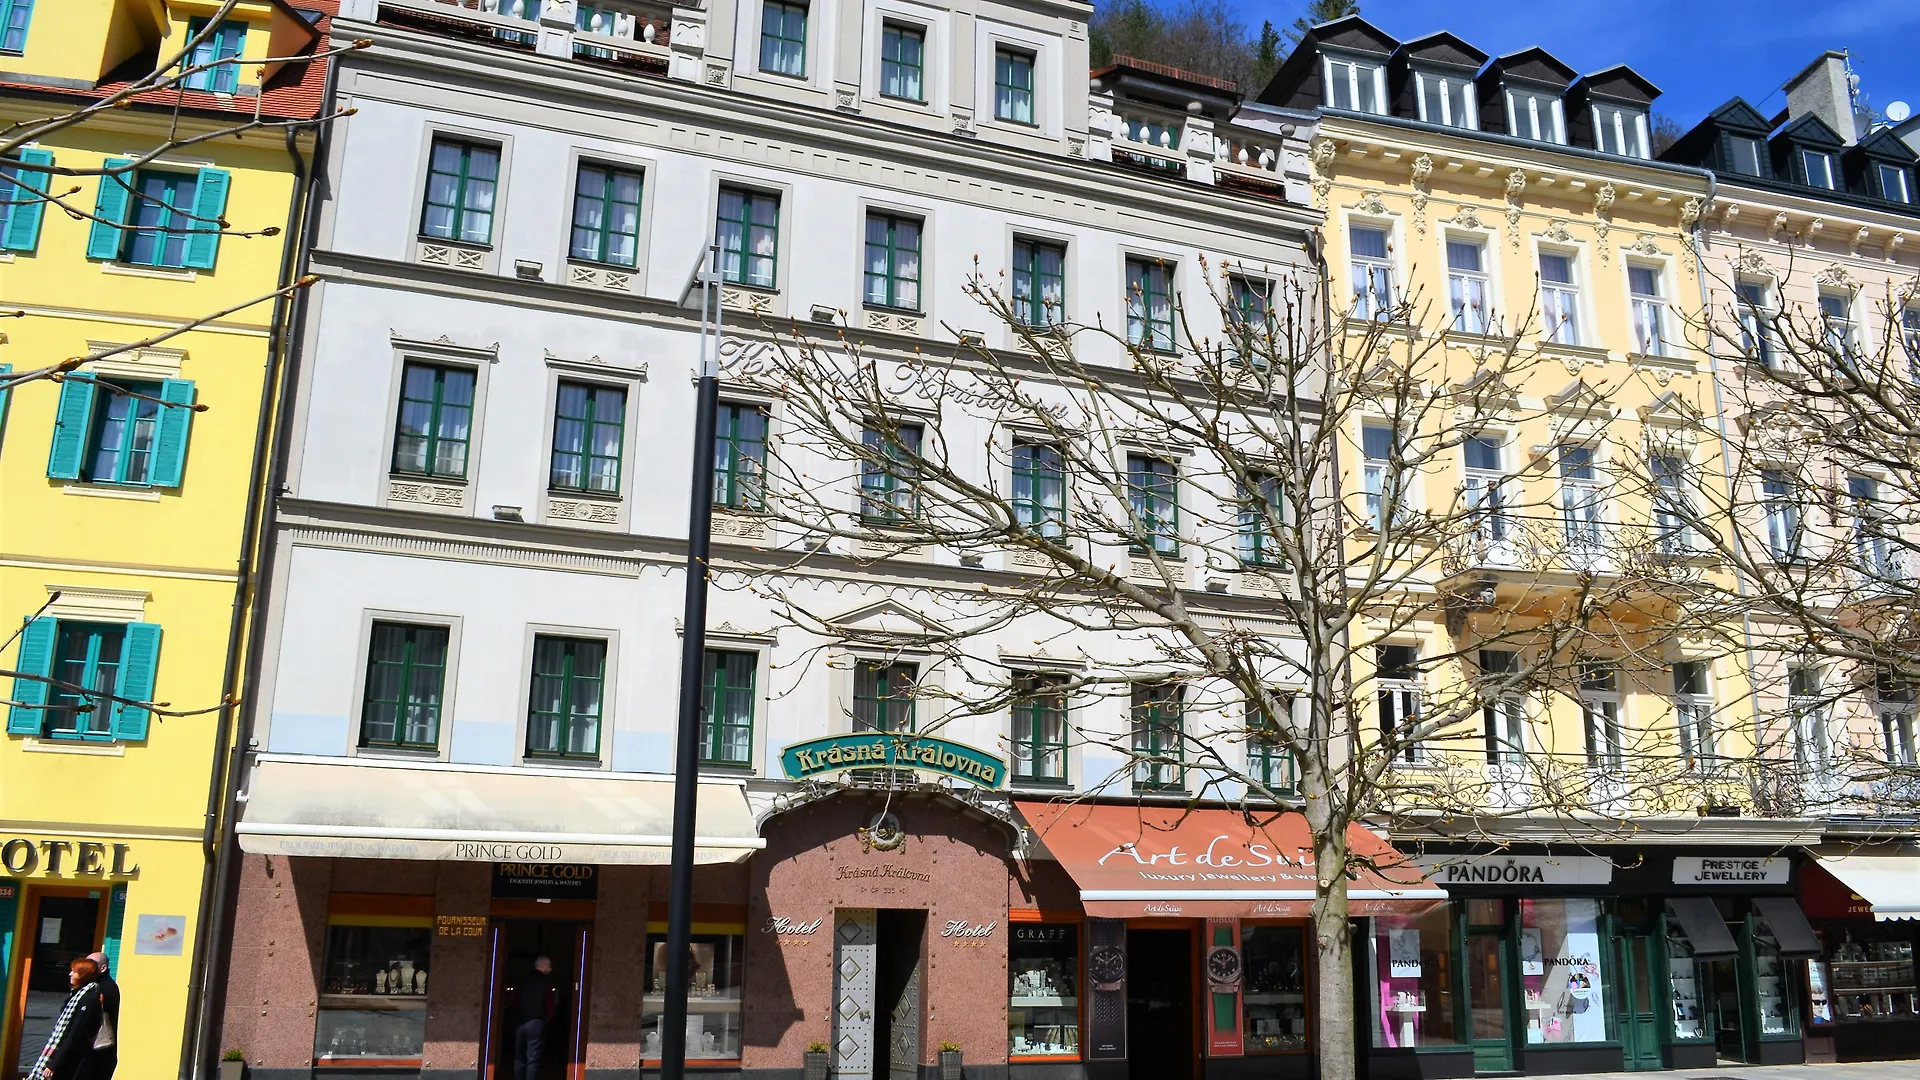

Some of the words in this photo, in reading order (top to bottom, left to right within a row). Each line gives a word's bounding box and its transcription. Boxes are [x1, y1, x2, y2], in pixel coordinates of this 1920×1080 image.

[795, 738, 887, 773] Krásná
[891, 739, 997, 783] Královna
[280, 840, 324, 850] EXQUISITE
[0, 838, 140, 877] OTEL
[455, 843, 512, 859] PRINCE
[516, 844, 562, 860] GOLD
[642, 851, 672, 860] JEWELR
[695, 852, 725, 860] ATCHES
[1097, 842, 1188, 866] Art
[1195, 835, 1244, 868] de
[500, 863, 549, 878] PRINCE
[552, 864, 593, 879] GOLD
[1702, 859, 1759, 871] PRESTIGE
[835, 865, 879, 881] Krásná
[879, 864, 931, 883] Královna
[1139, 871, 1196, 882] luxury
[1199, 871, 1276, 883] jewellery
[1280, 872, 1293, 882] &
[1447, 863, 1545, 883] PANDORA
[1694, 869, 1768, 882] JEWELLERY
[437, 915, 486, 926] FOURNISSEUR
[1207, 915, 1238, 924] HUBLOT
[438, 926, 449, 936] DE
[450, 926, 461, 936] LA
[463, 927, 483, 937] COUR
[761, 916, 823, 936] Hotel
[941, 919, 999, 938] Hotel
[1016, 928, 1065, 939] GRAFF
[1391, 958, 1433, 968] PANDO
[1544, 956, 1589, 967] PANDORA
